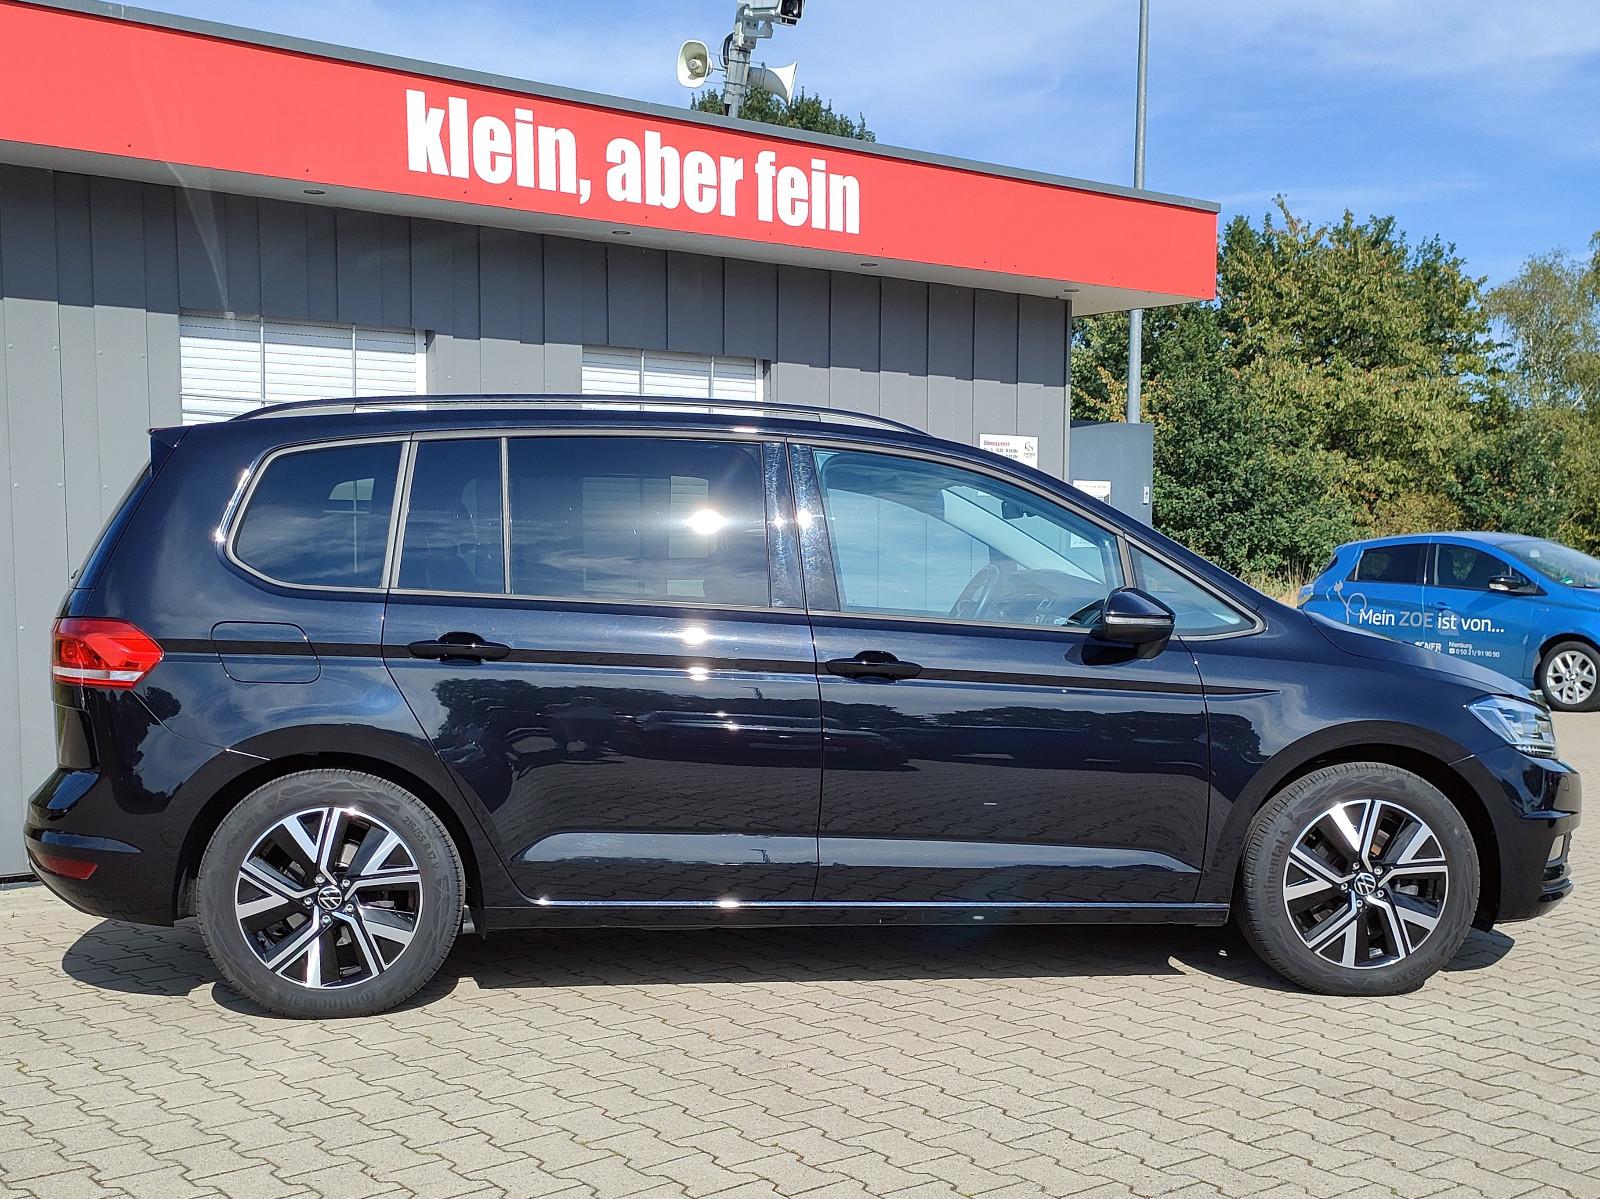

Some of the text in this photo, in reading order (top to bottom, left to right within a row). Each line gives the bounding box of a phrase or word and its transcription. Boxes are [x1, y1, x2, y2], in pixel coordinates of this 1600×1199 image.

[406, 89, 861, 235] klein, aber fein
[1359, 608, 1505, 633] Mein ZOE ist von...
